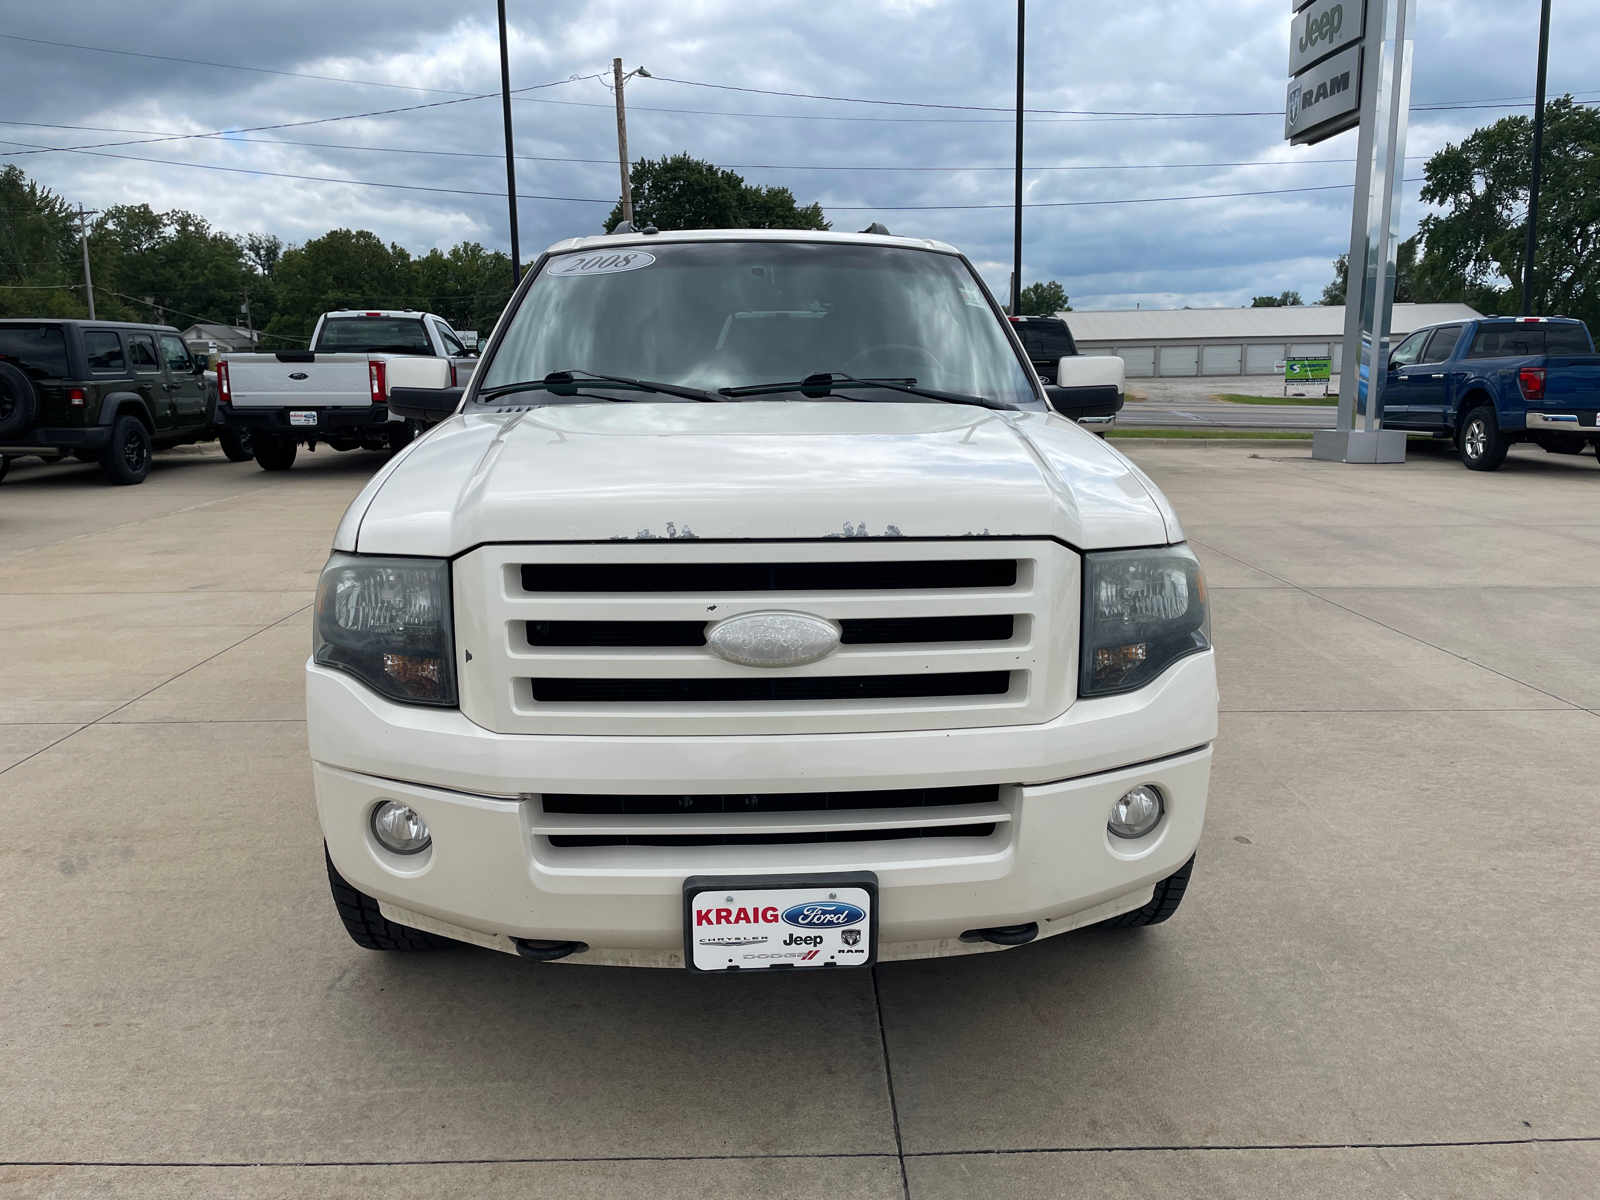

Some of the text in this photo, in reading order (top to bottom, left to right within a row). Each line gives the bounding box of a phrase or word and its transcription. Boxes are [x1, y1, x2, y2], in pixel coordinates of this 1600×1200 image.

[1299, 4, 1343, 53] Jeep
[1302, 71, 1350, 110] RAM
[562, 253, 638, 273] 2008
[741, 624, 808, 650] Ford
[696, 906, 779, 926] KRAIG
[798, 906, 848, 924] Ford
[782, 933, 823, 947] Jeep
